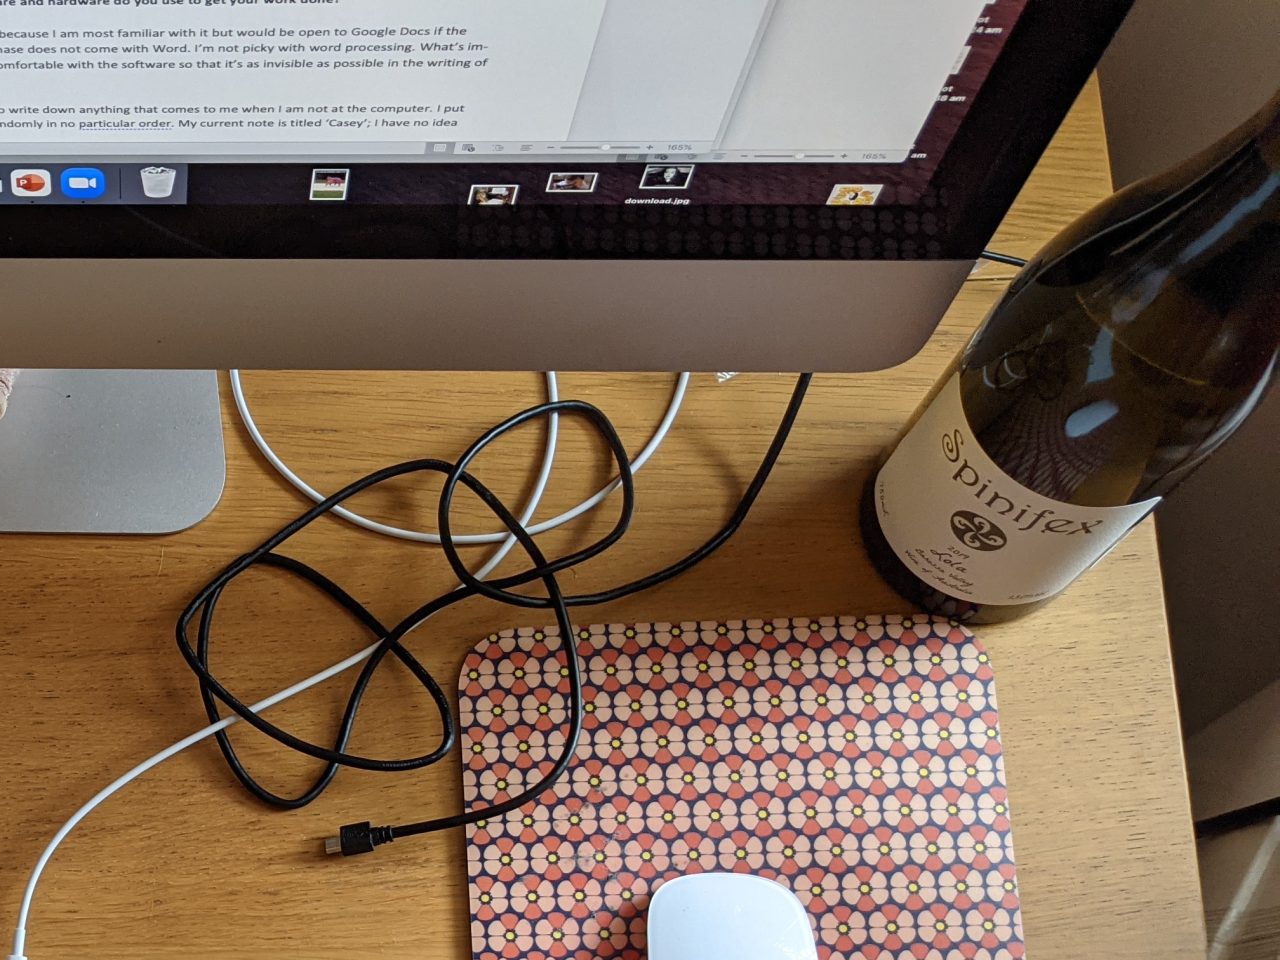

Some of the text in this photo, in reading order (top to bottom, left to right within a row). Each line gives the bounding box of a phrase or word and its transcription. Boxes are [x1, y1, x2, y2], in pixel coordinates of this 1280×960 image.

[82, 30, 114, 38] most
[117, 28, 165, 37] familiar
[168, 28, 195, 37] with
[199, 28, 208, 37] it
[212, 28, 233, 37] but
[236, 27, 275, 36] would
[279, 27, 294, 36] be
[298, 29, 330, 38] open
[334, 28, 347, 36] to
[351, 26, 396, 38] Google
[399, 26, 430, 35] Docs
[433, 26, 443, 35] if
[446, 26, 466, 35] the
[27, 44, 56, 53] does
[121, 44, 148, 53] with
[152, 43, 190, 53] Word.
[194, 43, 214, 52] I'm
[242, 43, 274, 54] picky
[278, 43, 305, 52] with
[309, 43, 341, 52] word
[345, 42, 415, 53] processing.
[420, 42, 464, 51] What's
[467, 42, 488, 51] im-
[66, 60, 94, 69] with
[97, 60, 118, 68] the
[121, 59, 175, 69] software
[196, 59, 221, 68] that
[225, 59, 242, 68] it's
[263, 59, 313, 68] invisible
[333, 58, 383, 69] possible
[387, 59, 398, 67] in
[402, 58, 423, 67] the
[427, 58, 471, 68] writing
[474, 58, 488, 66] of
[624, 197, 690, 206] download.jpg
[941, 429, 1103, 536] Spinifex
[930, 549, 967, 573] Lola
